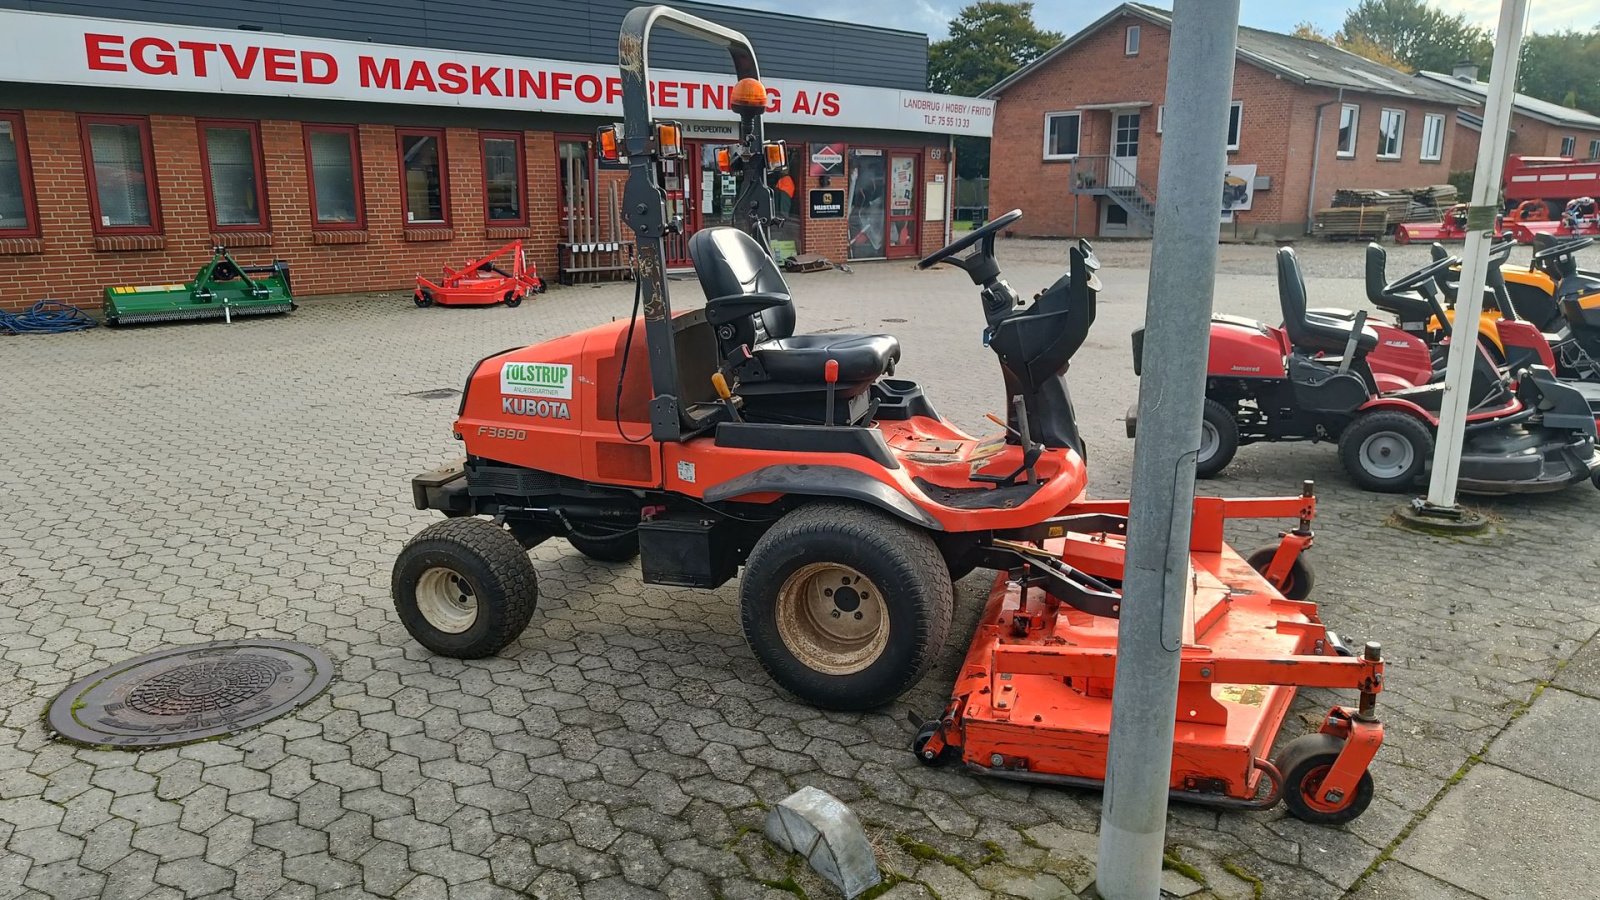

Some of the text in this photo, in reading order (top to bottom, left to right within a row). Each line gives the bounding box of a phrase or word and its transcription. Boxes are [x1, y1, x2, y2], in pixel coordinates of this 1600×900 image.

[84, 32, 841, 117] EGTVED MASKINFORETNIG A/S
[903, 98, 940, 112] LANDBRUG
[945, 103, 967, 114] HOBBY
[971, 105, 992, 117] FRITID
[693, 124, 732, 134] EKSPEDITION
[938, 116, 945, 126] 75
[946, 117, 953, 127] 55
[955, 118, 961, 128] 13
[962, 119, 970, 128] 33
[931, 149, 941, 160] 69
[505, 364, 568, 384] TOLSTRUP
[501, 397, 571, 420] KUBOTA
[477, 426, 528, 441] F3890
